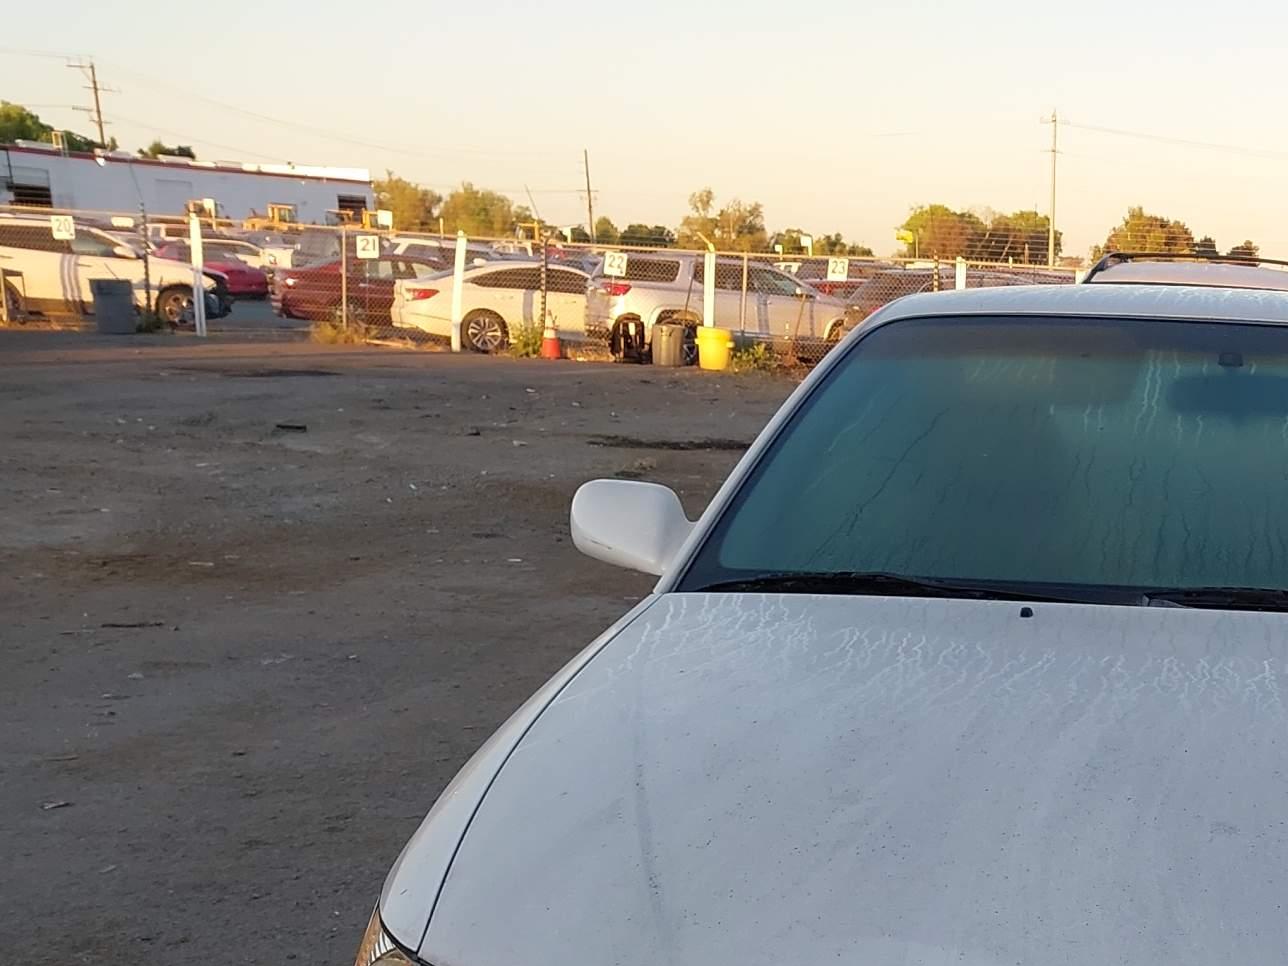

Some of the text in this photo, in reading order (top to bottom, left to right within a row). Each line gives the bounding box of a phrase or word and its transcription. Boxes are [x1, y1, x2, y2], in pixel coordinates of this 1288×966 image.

[54, 218, 72, 233] 20
[360, 238, 376, 251] 21
[608, 254, 624, 269] 22
[831, 260, 845, 274] 23
